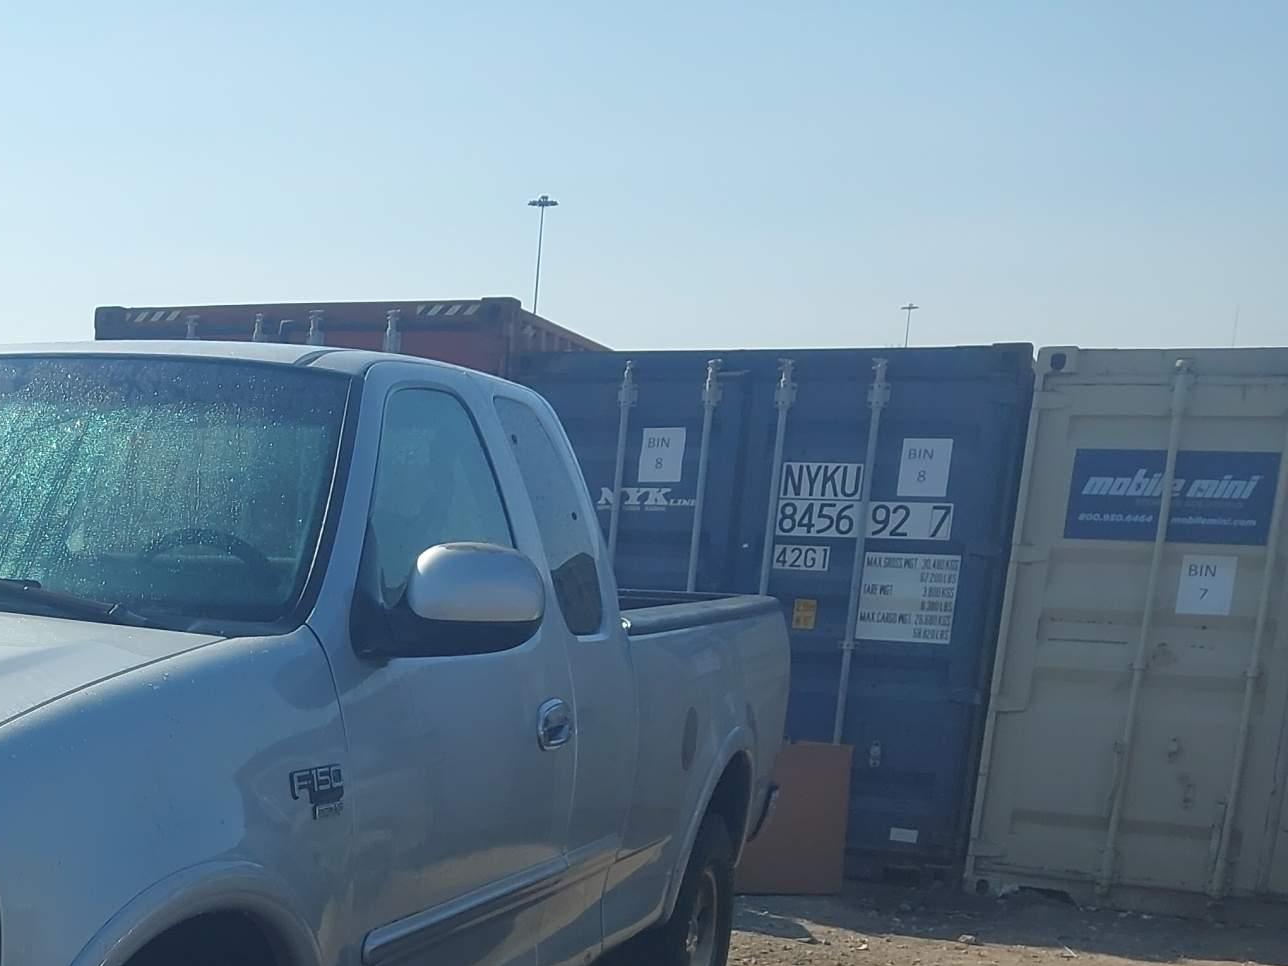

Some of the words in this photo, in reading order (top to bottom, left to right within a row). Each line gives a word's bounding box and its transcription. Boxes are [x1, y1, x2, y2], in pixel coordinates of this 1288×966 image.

[648, 437, 670, 448] BIN
[908, 449, 934, 460] BIN
[655, 458, 663, 470] 8
[782, 465, 861, 498] NYKU
[916, 470, 925, 482] 8
[1186, 475, 1263, 499] mini
[598, 487, 671, 505] NYK
[778, 502, 855, 535] 8456
[871, 503, 911, 537] 92
[930, 505, 952, 538] 7
[775, 548, 828, 570] 42G1
[1188, 564, 1216, 577] BIN
[1199, 588, 1209, 600] 7
